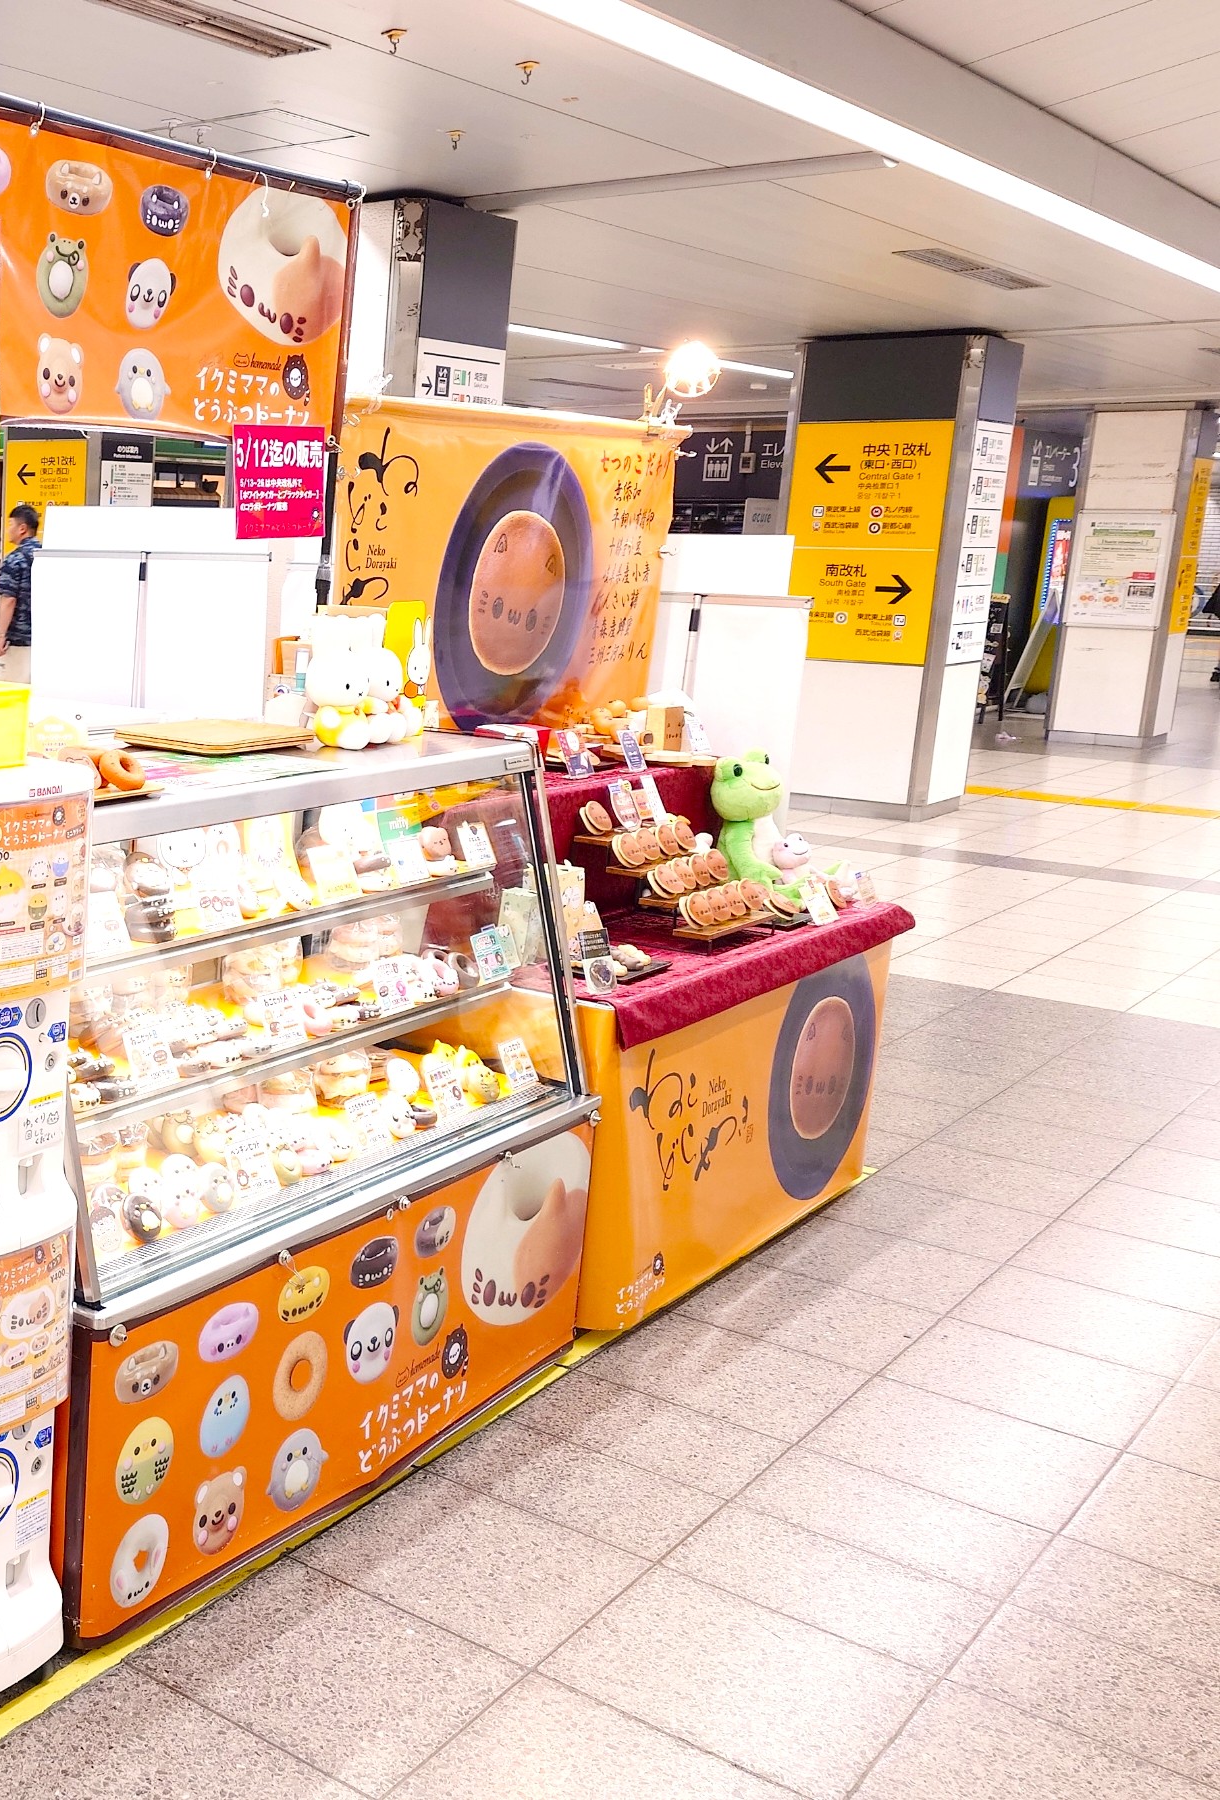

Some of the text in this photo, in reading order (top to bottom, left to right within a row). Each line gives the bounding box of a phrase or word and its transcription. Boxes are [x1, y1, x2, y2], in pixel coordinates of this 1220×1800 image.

[249, 354, 282, 371] homemade
[195, 366, 280, 397] イクミママの
[193, 397, 311, 425] どうぶつドーナツ
[236, 436, 323, 470] 5/12迄の販売
[862, 442, 932, 458] 中央1改札
[40, 456, 77, 467] 中央1改札
[859, 458, 918, 471] (東口・西口)
[1068, 446, 1081, 488] 3
[858, 471, 891, 481] Central
[892, 471, 915, 481] Gate
[884, 506, 913, 514] 丸ノ内線
[366, 543, 386, 557] Neko
[365, 556, 398, 573] Dorayaki
[825, 563, 868, 578] 南改札
[819, 578, 867, 588] South Gate
[36, 784, 63, 797] BANDAI
[3, 819, 52, 834] イクミママの
[2, 828, 66, 847] どうぶつドーナツ
[708, 1075, 727, 1097] Neko
[701, 1087, 732, 1118] Dorayaki
[408, 1342, 442, 1379] homemade
[359, 1371, 439, 1440] イクミママの
[357, 1380, 468, 1474] どうぶつドーナツ
